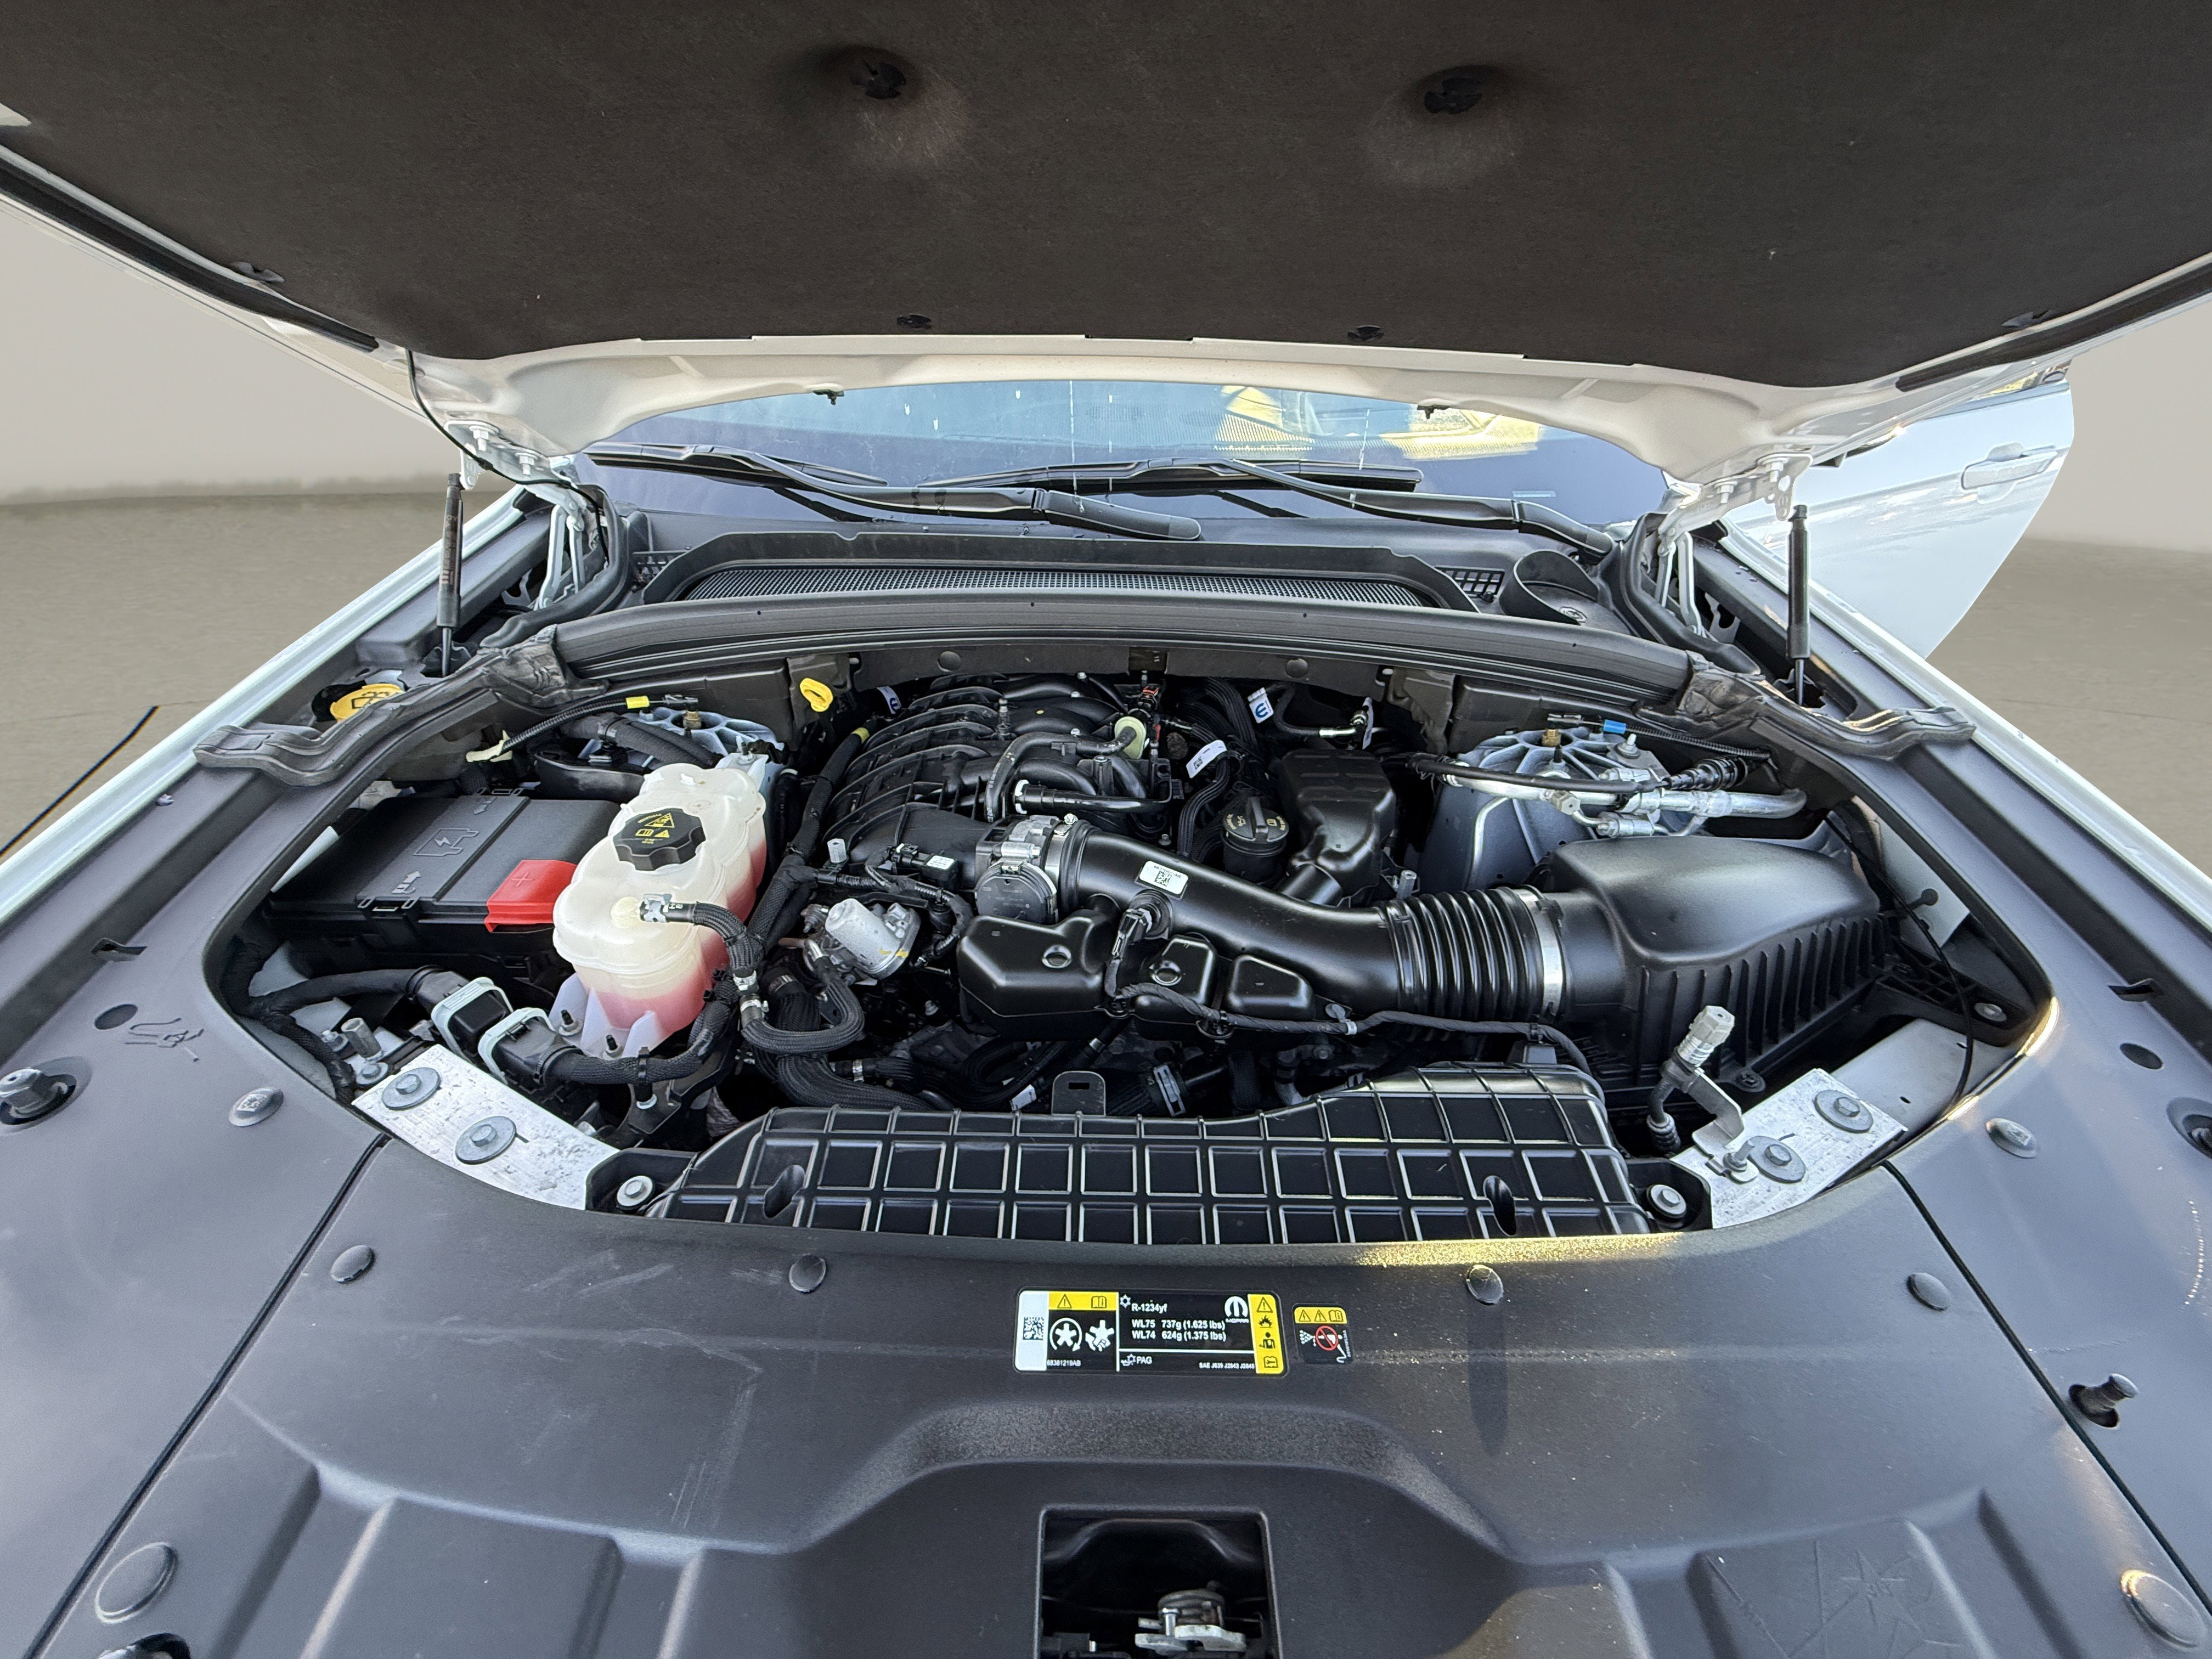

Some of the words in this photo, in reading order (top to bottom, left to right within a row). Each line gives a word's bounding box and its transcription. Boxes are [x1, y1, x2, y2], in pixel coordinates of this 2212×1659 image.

[1132, 1303, 1167, 1313] R-1234yf
[1132, 1319, 1155, 1328] WL75
[1161, 1319, 1182, 1330] 737g
[1183, 1320, 1208, 1330] (1.625
[1209, 1320, 1225, 1331] lbs)
[1132, 1330, 1156, 1339] WL74
[1161, 1330, 1182, 1341] 624g
[1184, 1331, 1209, 1342] (1.375
[1210, 1331, 1226, 1342] lbs)
[1136, 1356, 1152, 1364] PAG
